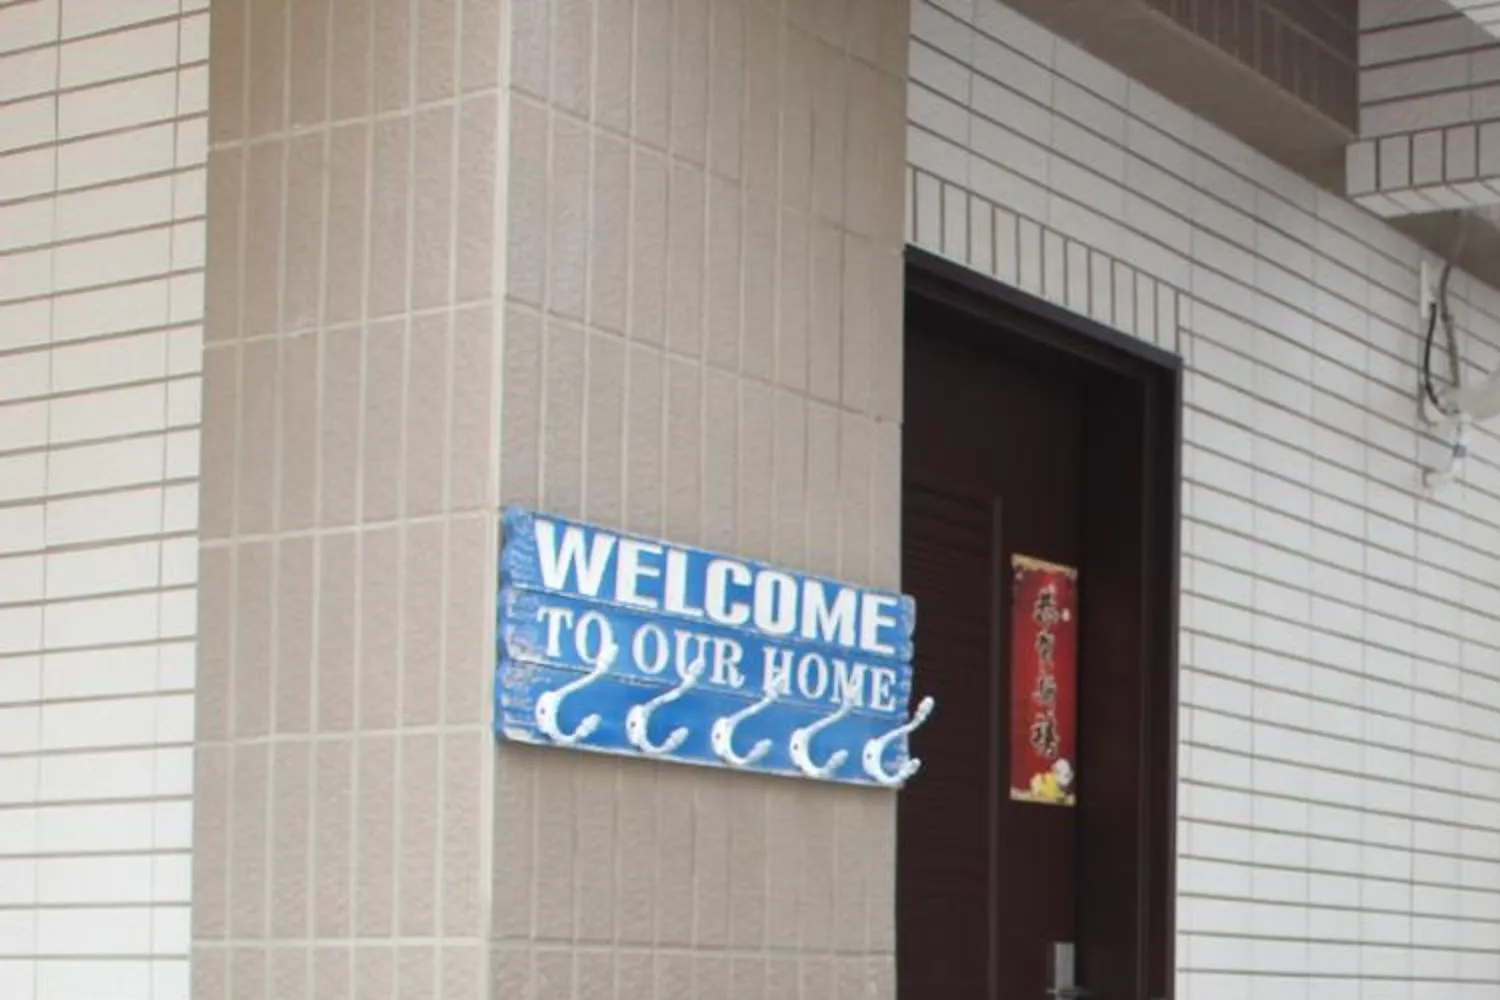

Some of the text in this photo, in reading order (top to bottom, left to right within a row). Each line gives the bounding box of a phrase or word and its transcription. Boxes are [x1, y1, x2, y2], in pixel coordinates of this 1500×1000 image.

[533, 519, 899, 655] WELCOME
[536, 606, 898, 713] TO OUR HOME
